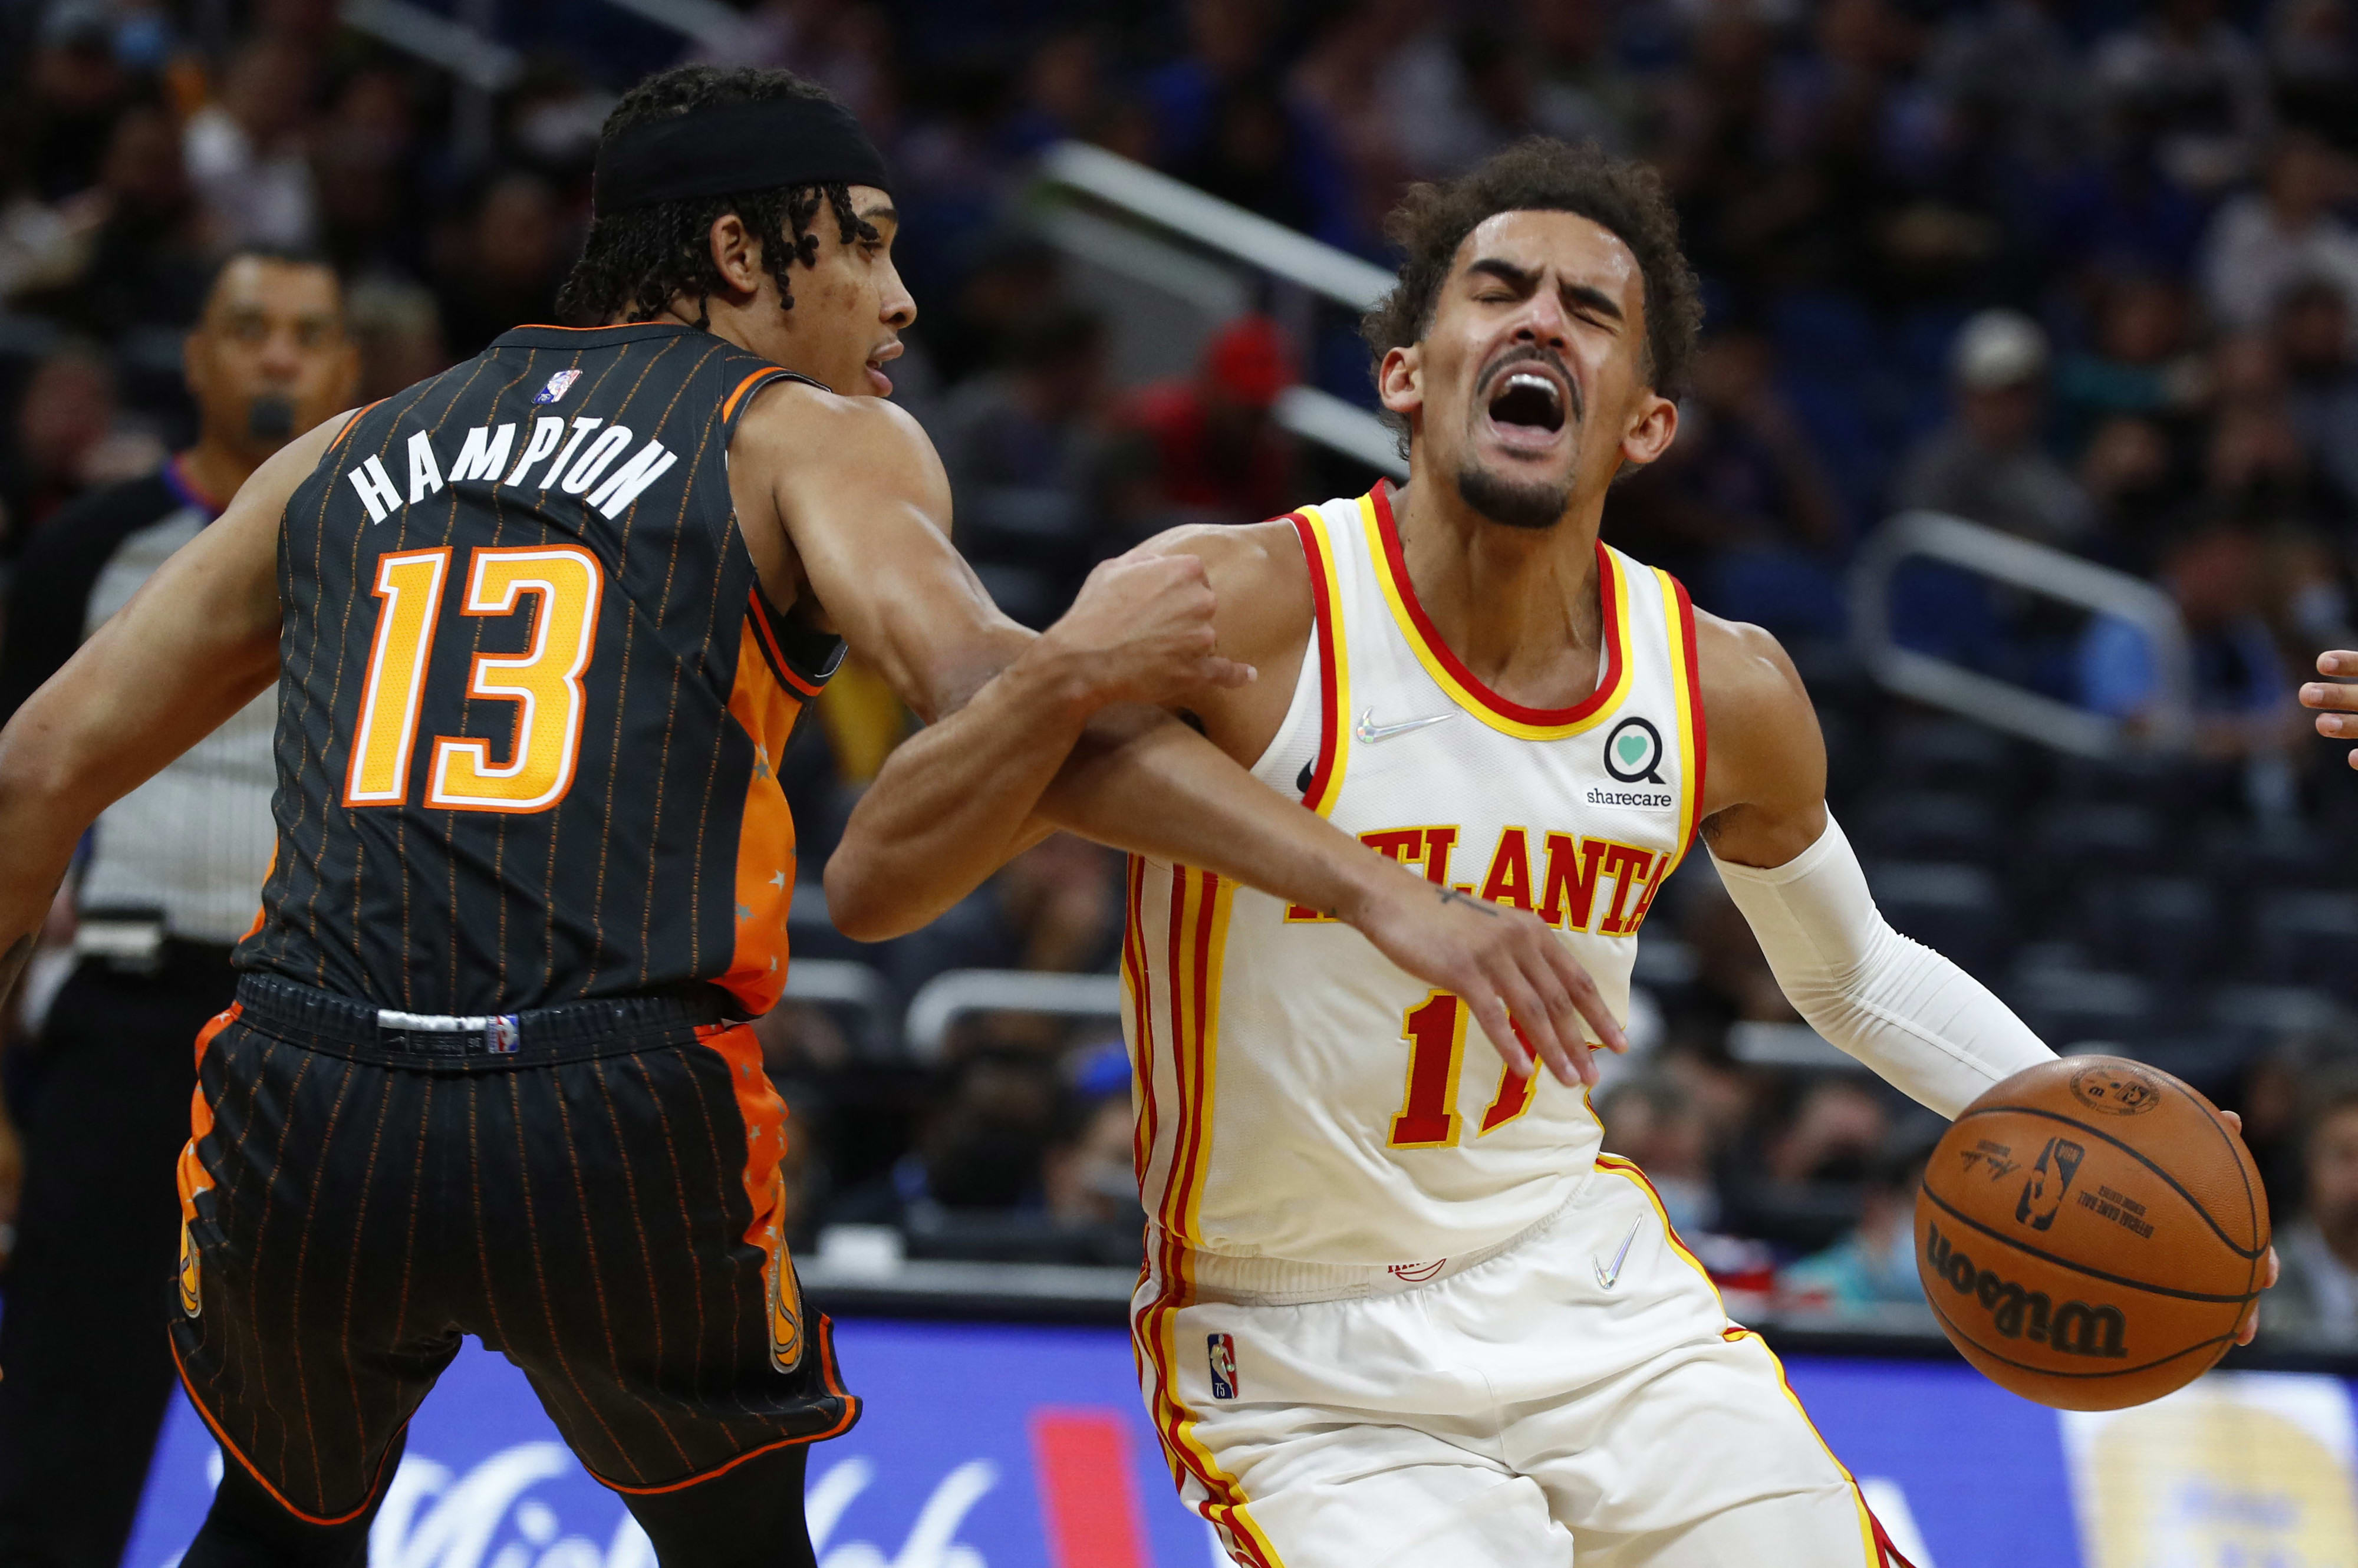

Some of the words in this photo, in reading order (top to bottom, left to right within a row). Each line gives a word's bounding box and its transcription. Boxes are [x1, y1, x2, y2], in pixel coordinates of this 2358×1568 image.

[348, 416, 678, 525] HAMPTON
[341, 543, 604, 814] 13
[1587, 788, 1672, 807] sharecare
[1927, 1220, 2129, 1359] Wilson
[1215, 1383, 1226, 1396] 75
